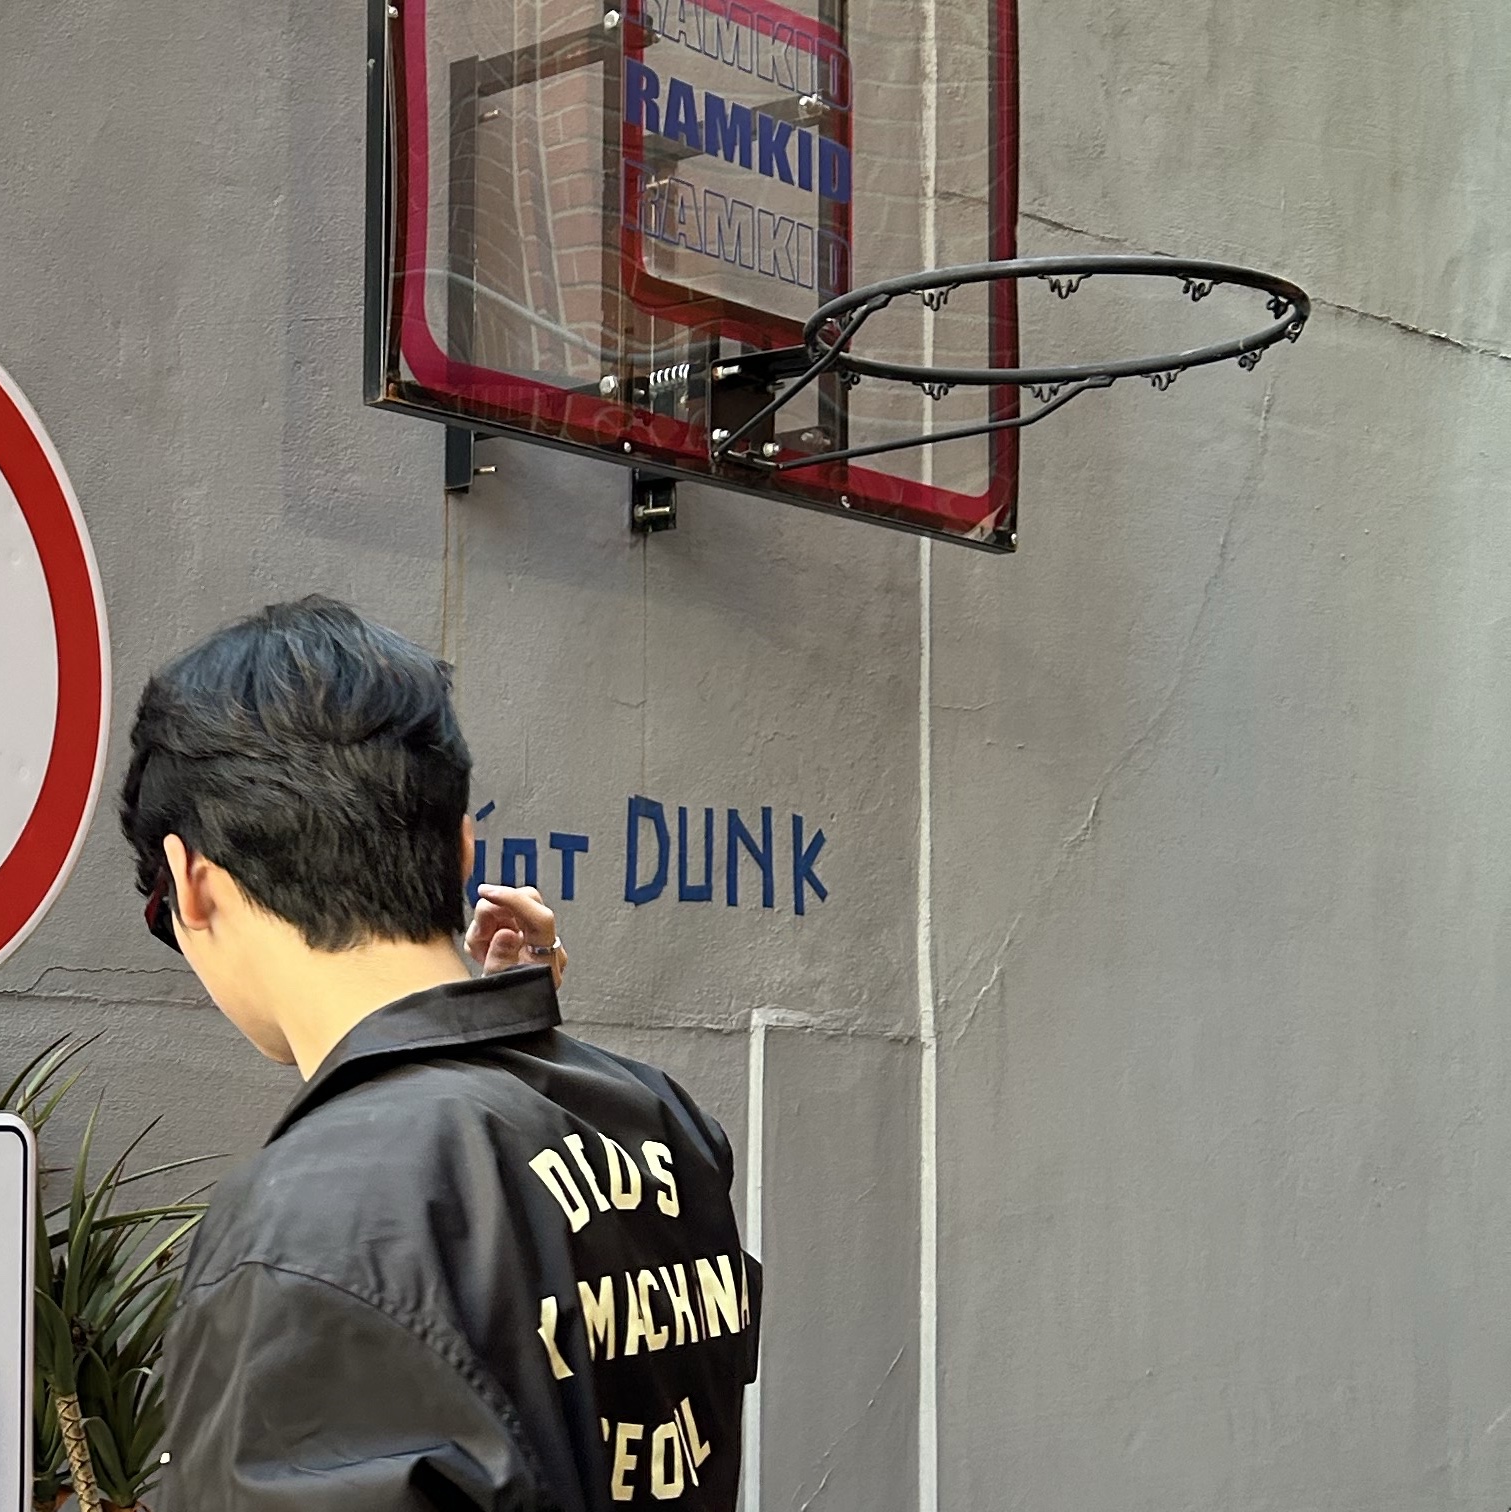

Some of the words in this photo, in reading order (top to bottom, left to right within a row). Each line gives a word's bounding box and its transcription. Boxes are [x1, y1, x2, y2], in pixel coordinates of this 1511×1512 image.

[625, 56, 852, 204] RAMKID
[622, 159, 852, 299] RAMKID
[624, 794, 829, 916] DUNK
